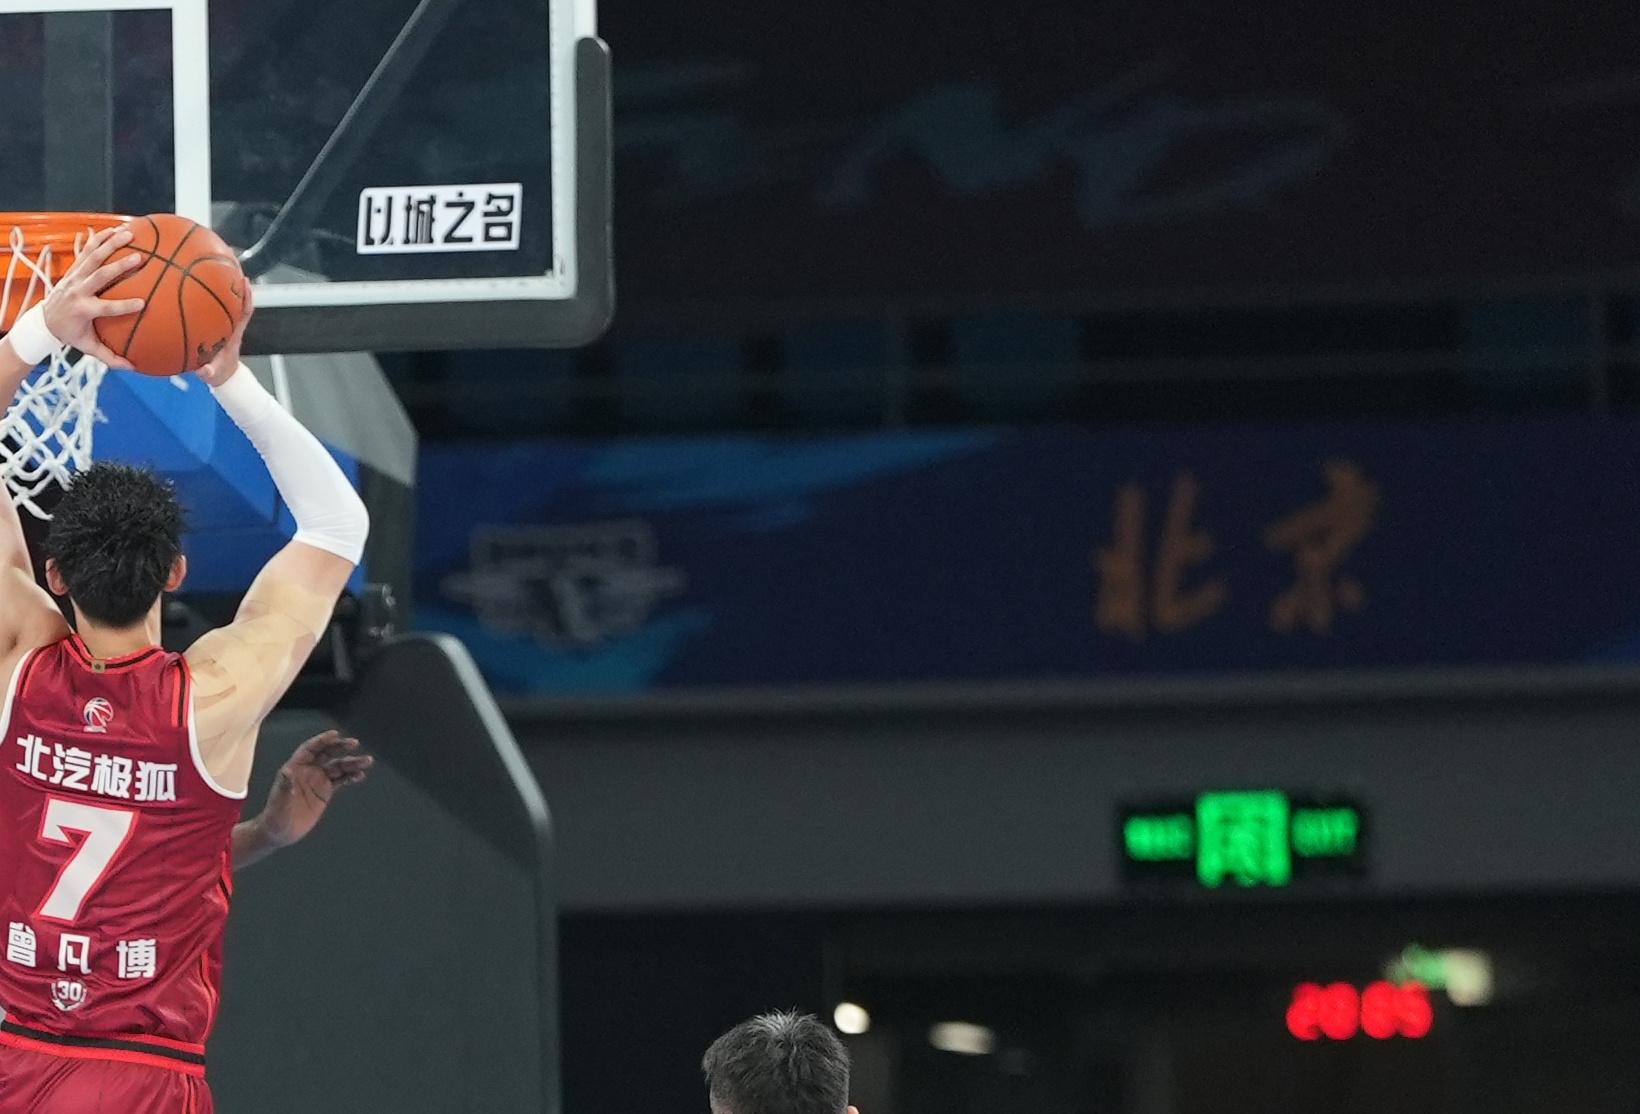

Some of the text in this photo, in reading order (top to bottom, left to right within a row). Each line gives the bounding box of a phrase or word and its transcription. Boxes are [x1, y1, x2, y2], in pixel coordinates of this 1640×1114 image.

[364, 190, 515, 246] 以城之名
[1093, 458, 1382, 642] 北京
[16, 733, 178, 802] 北汽极狐
[33, 794, 140, 924] 7
[6, 921, 158, 979] 曾凡博
[57, 979, 82, 1001] 30
